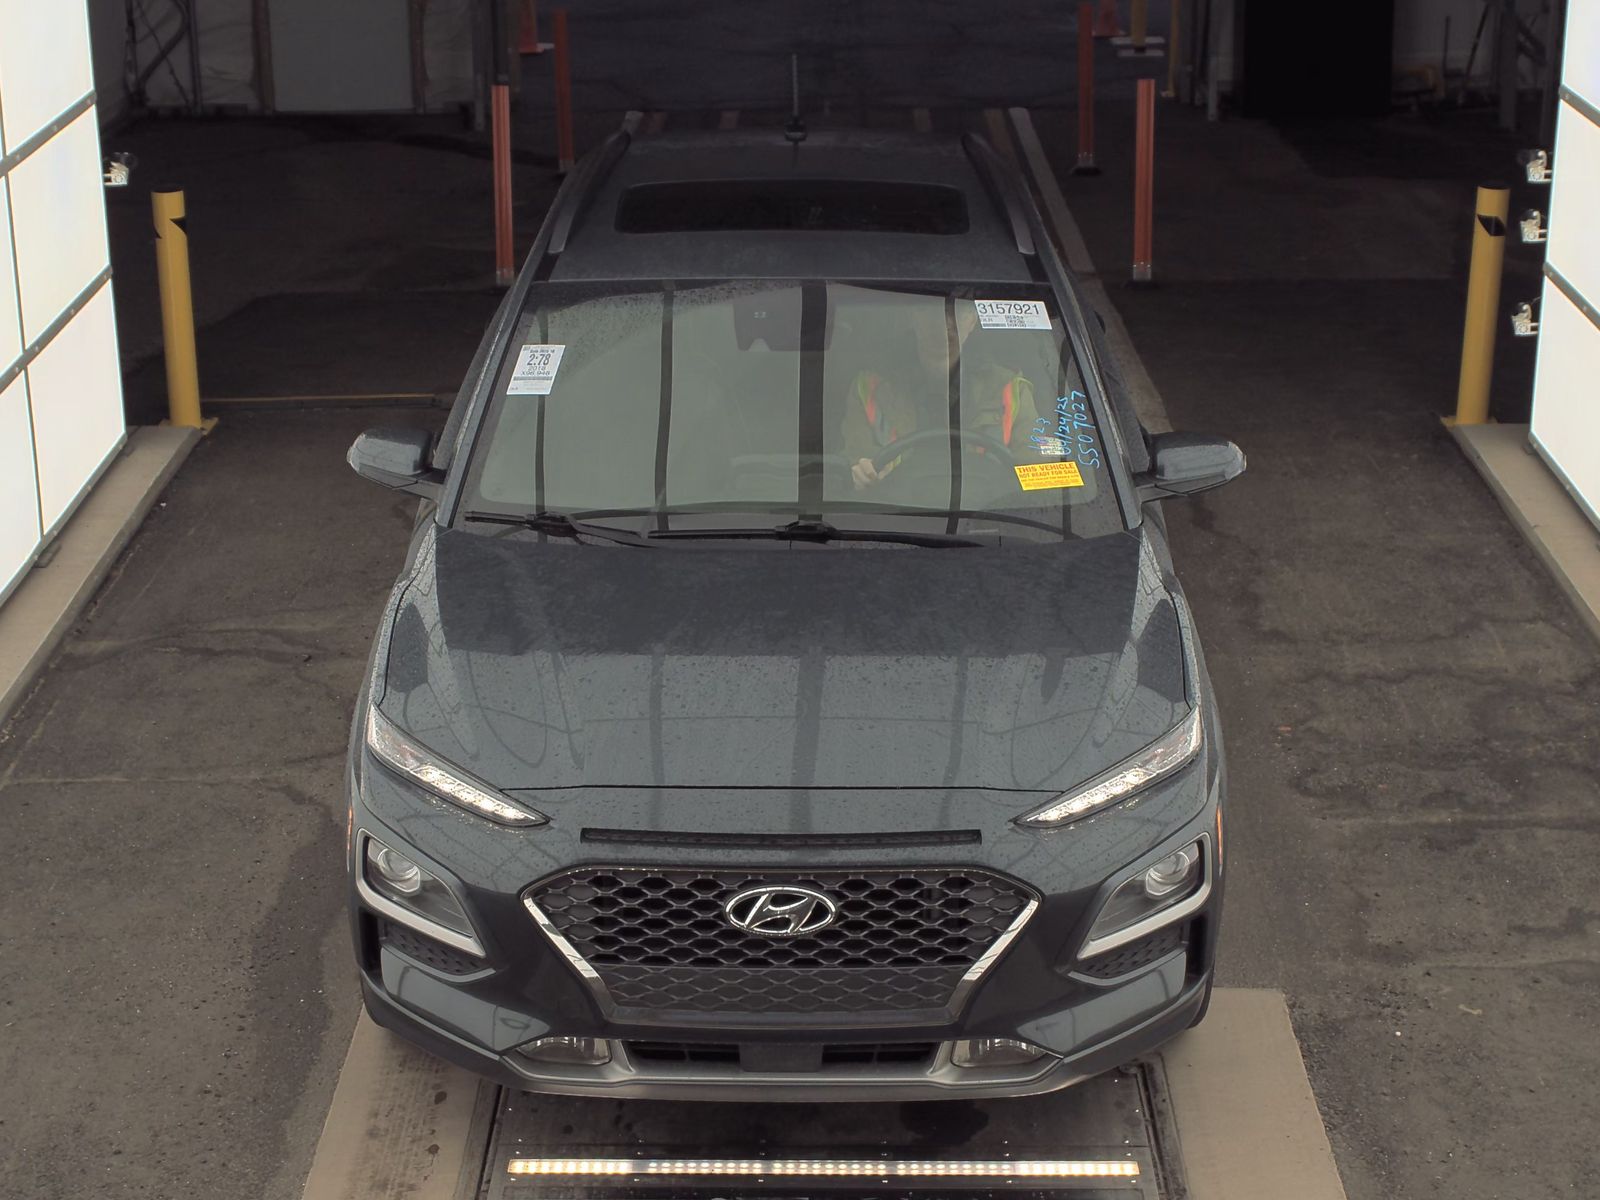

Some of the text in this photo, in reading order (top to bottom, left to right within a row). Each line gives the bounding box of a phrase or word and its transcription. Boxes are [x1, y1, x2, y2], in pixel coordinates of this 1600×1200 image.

[977, 303, 1040, 315] 3157921
[527, 353, 551, 366] 2:78
[1071, 390, 1100, 468] 5507027
[1016, 462, 1075, 474] THIS VEHICLE
